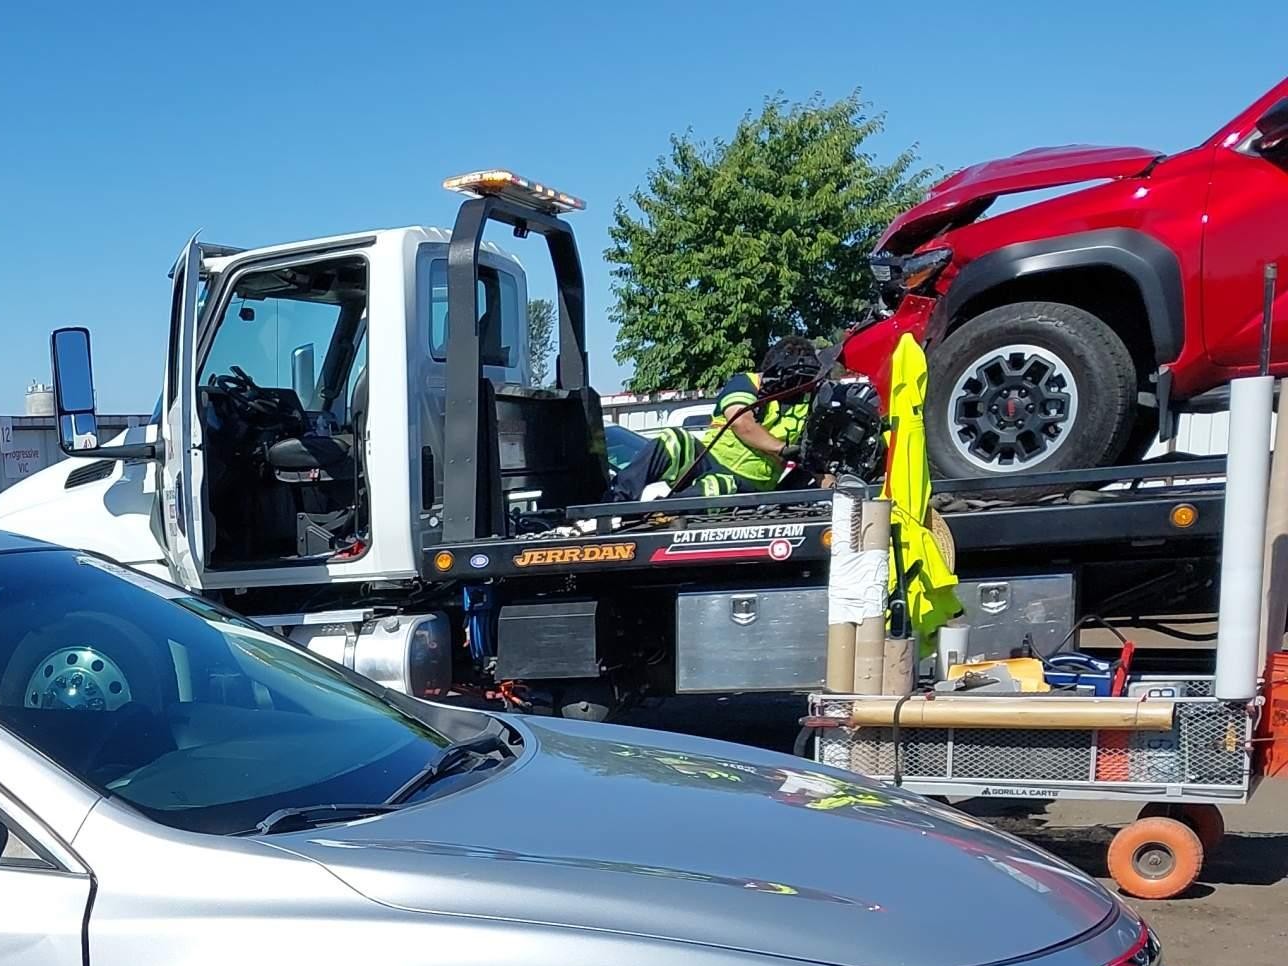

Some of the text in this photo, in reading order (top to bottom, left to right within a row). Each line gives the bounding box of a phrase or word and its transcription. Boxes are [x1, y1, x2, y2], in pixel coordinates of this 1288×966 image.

[1, 427, 11, 443] 12
[17, 462, 29, 473] VIC
[673, 524, 804, 543] CAT RESPONSE TEAM
[992, 788, 1058, 797] GORILLA CARTS
